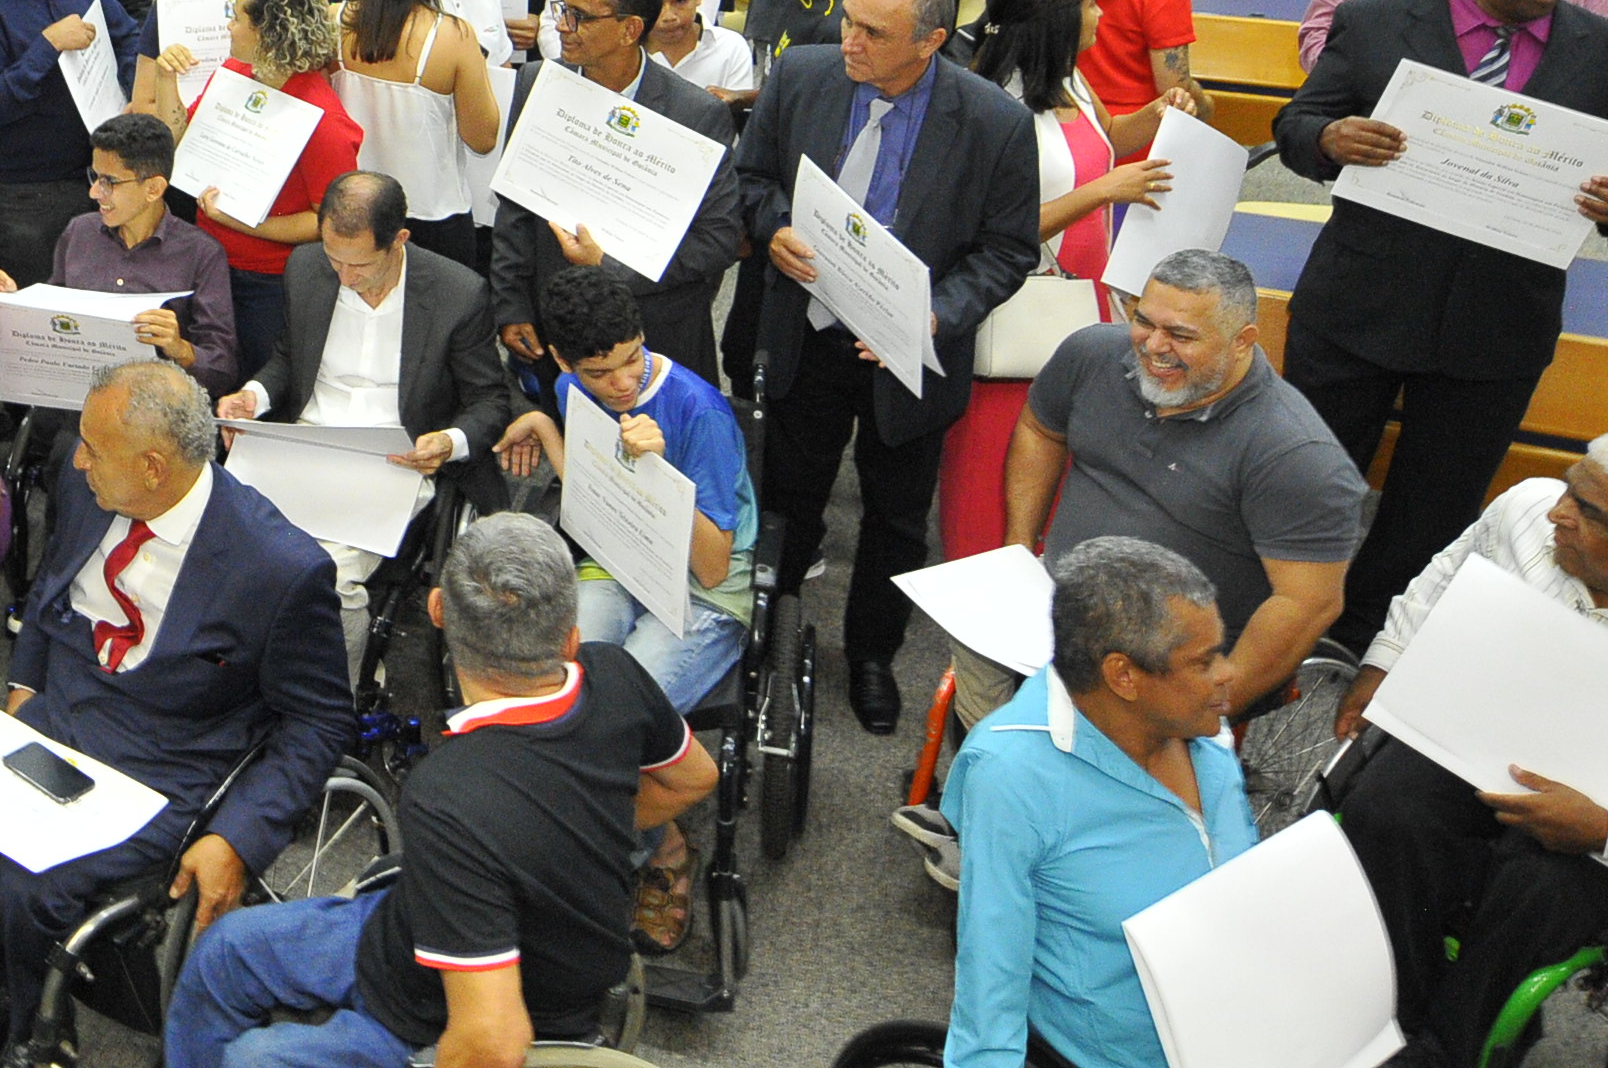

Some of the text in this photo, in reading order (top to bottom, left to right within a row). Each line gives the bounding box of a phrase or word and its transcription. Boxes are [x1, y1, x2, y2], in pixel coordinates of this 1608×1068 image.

[557, 108, 675, 173] Diploma de Honra ao Mérito
[564, 126, 657, 176] Câmara Municipal de Goiânia
[1421, 111, 1469, 131] Diploma
[1488, 132, 1524, 150] Honra
[1527, 147, 1541, 155] ao
[1543, 151, 1583, 167] Mérito
[568, 155, 581, 166] Tito
[584, 164, 601, 176] Alves
[1441, 159, 1519, 187] Jovenal da Silva
[1525, 158, 1559, 172] Goiânia
[12, 331, 45, 341] Diploma
[59, 336, 85, 346] Honra
[99, 341, 127, 352] Mérito
